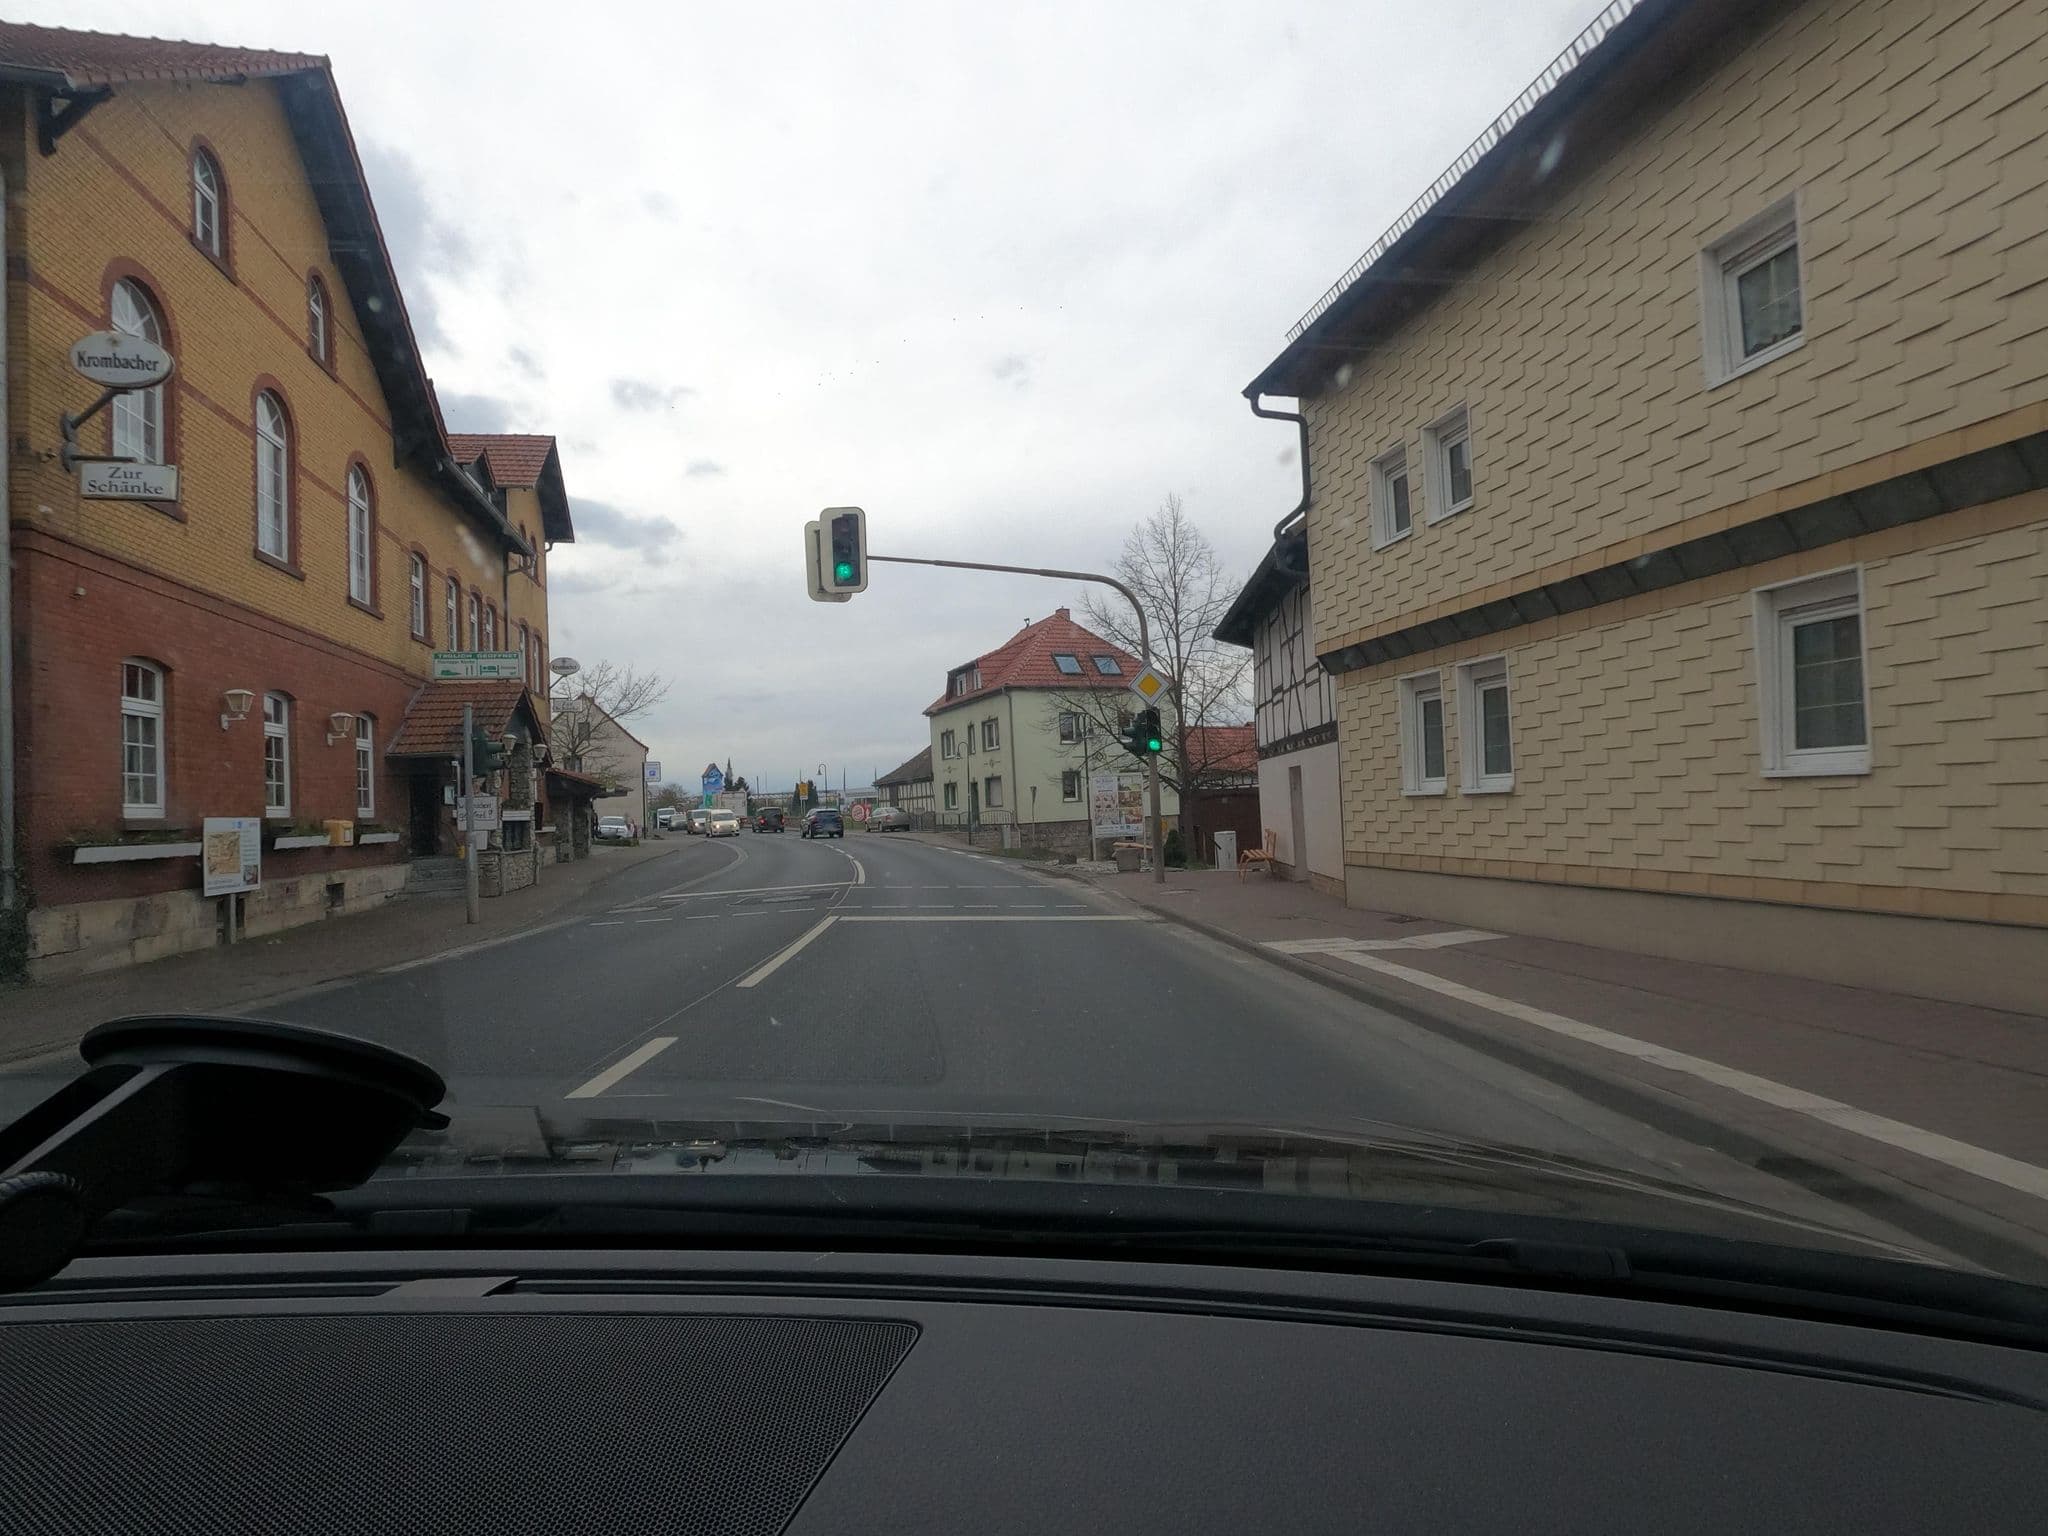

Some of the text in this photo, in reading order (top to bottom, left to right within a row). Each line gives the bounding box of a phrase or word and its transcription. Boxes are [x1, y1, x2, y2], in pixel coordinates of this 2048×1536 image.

[77, 351, 160, 372] Krombacher
[108, 466, 143, 479] Zur
[87, 480, 164, 496] Schänke
